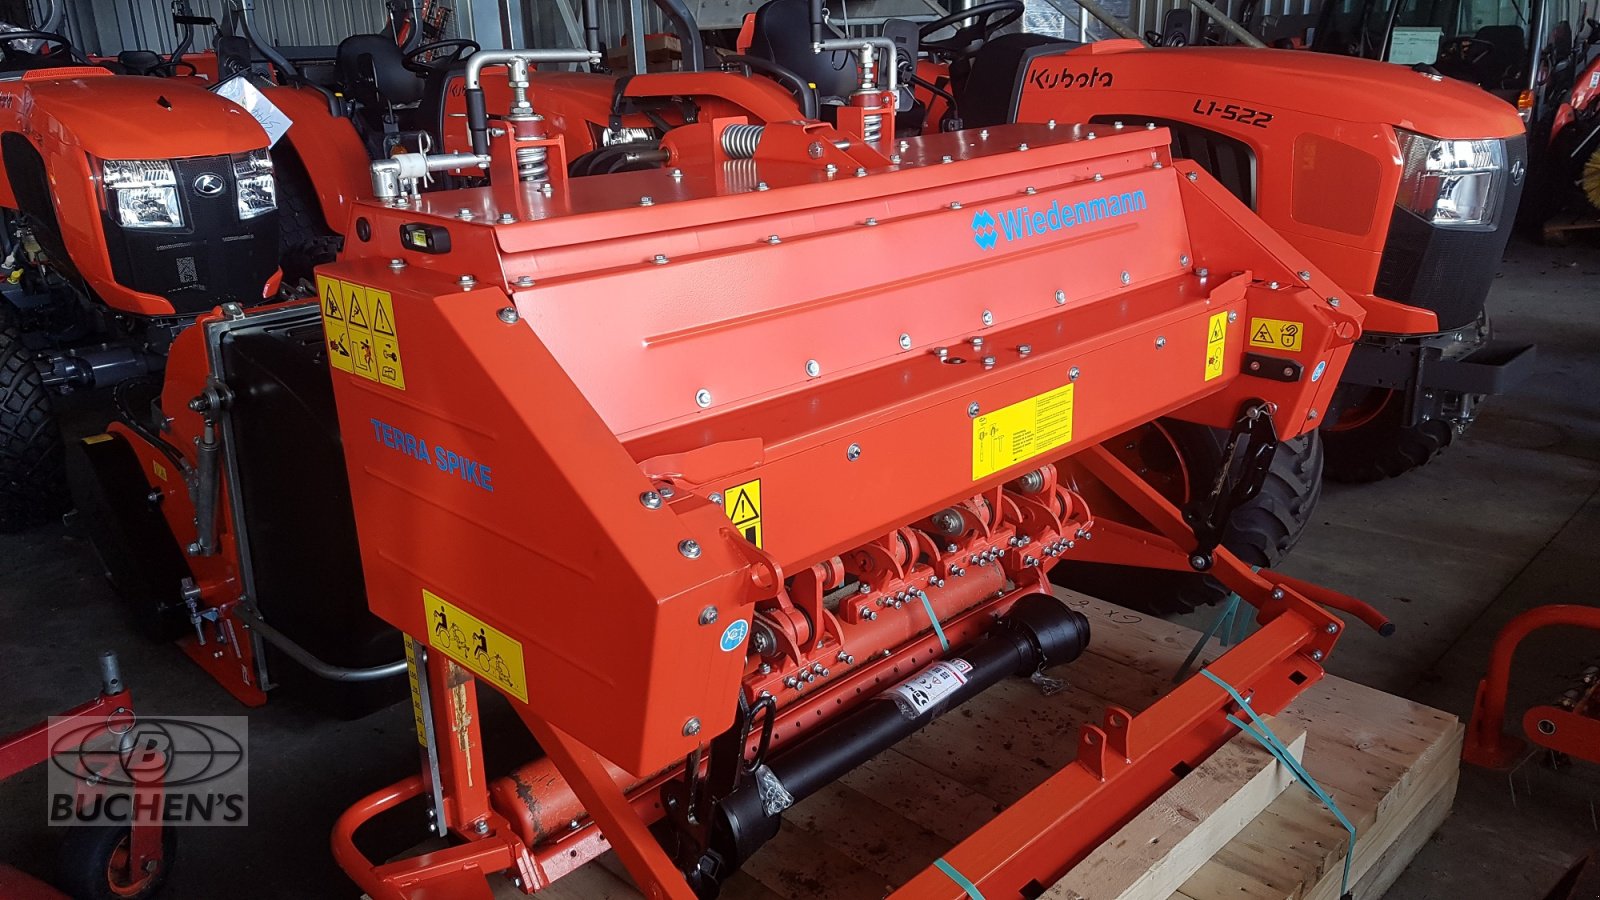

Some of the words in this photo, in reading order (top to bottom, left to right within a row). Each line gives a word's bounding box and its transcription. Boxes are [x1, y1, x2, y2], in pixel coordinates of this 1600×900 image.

[1030, 67, 1113, 89] Kubota
[1193, 99, 1274, 128] L1-522
[998, 190, 1147, 241] Wiedenmann
[369, 418, 431, 465] TERRA
[435, 446, 494, 492] SPIKE
